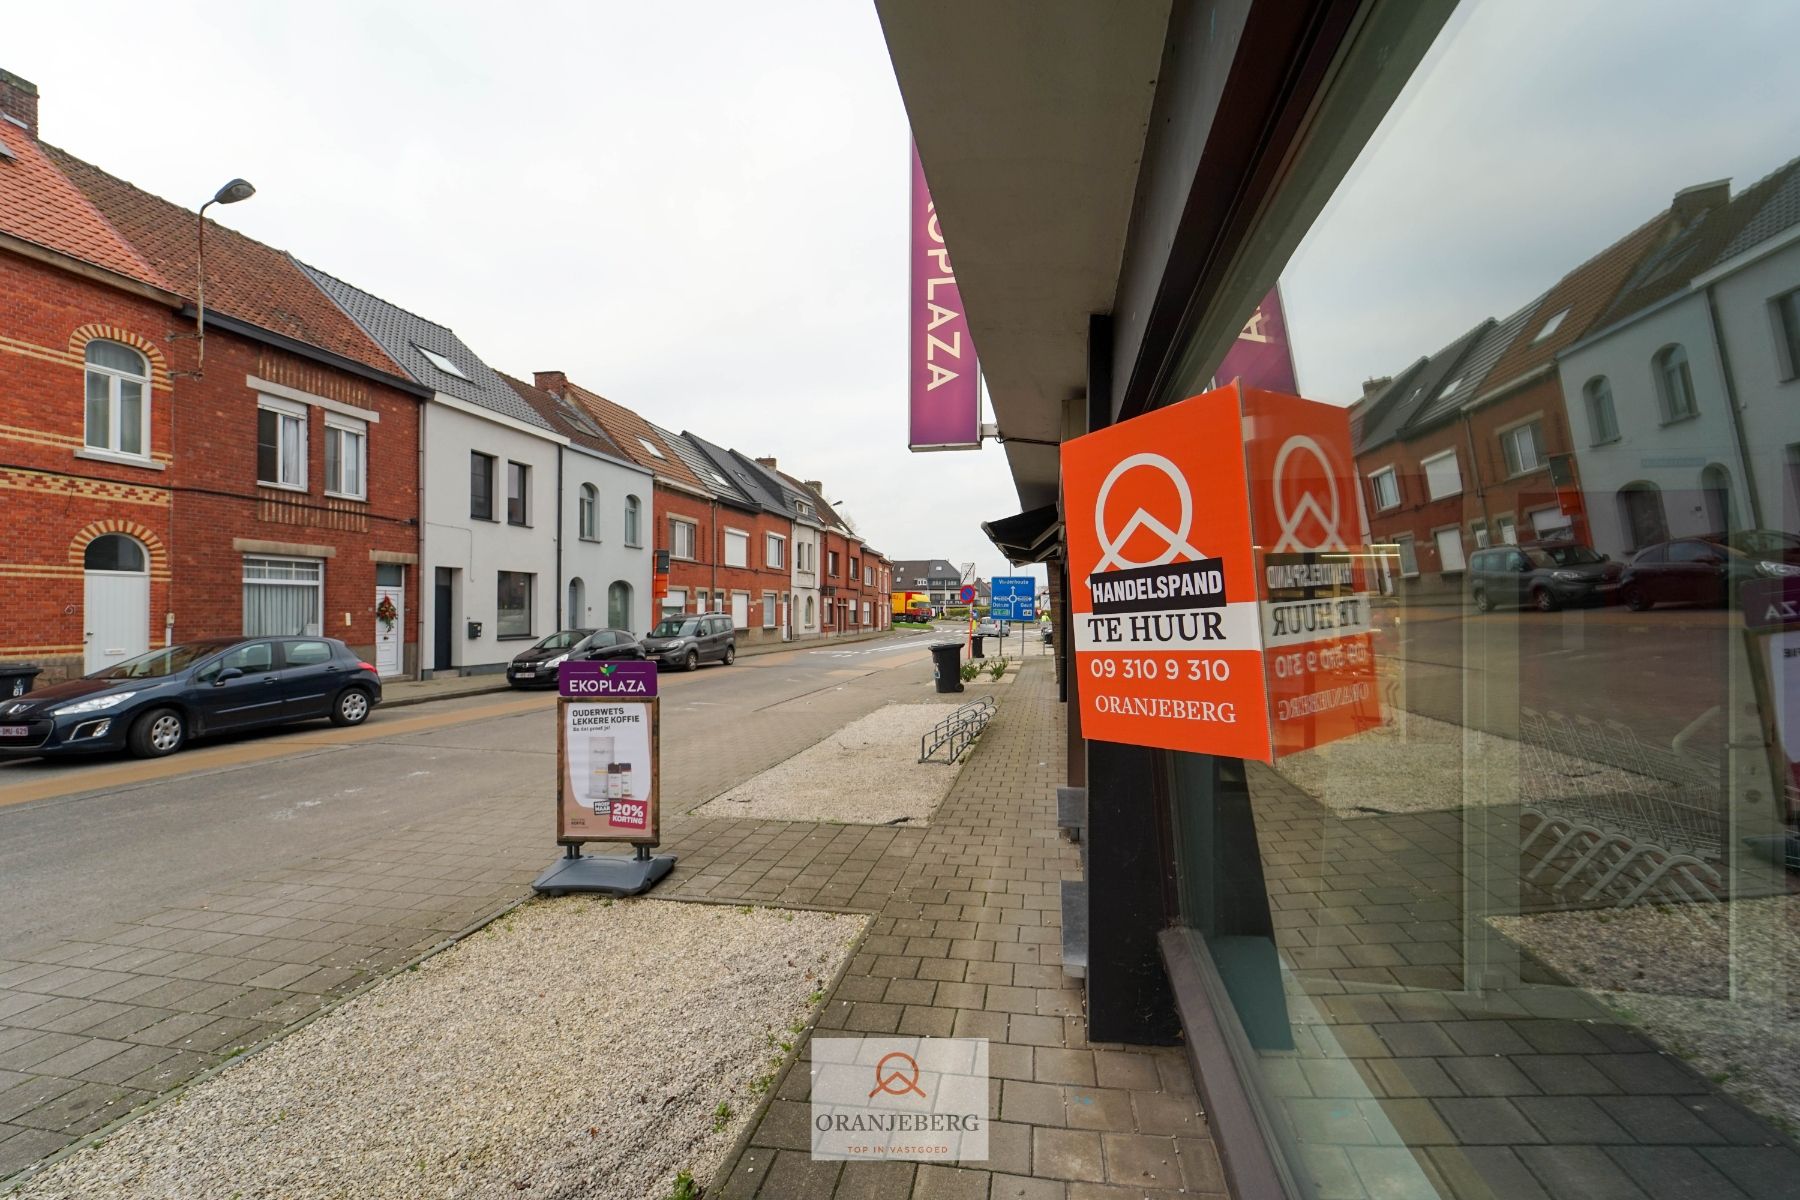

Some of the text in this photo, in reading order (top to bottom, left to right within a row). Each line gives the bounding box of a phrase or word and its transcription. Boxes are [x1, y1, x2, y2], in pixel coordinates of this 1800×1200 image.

[1092, 570, 1223, 604] HANDELSPAND
[1088, 611, 1226, 643] TE HUUR
[1090, 658, 1230, 682] 09 310 9 310
[569, 680, 646, 692] EKOPLAZA
[572, 708, 624, 717] OUDERWETS
[1095, 695, 1236, 723] ORANJEBERG
[572, 715, 640, 726] LEKKERE KOFFIE
[614, 803, 644, 817] 20%
[612, 815, 643, 824] KORTING
